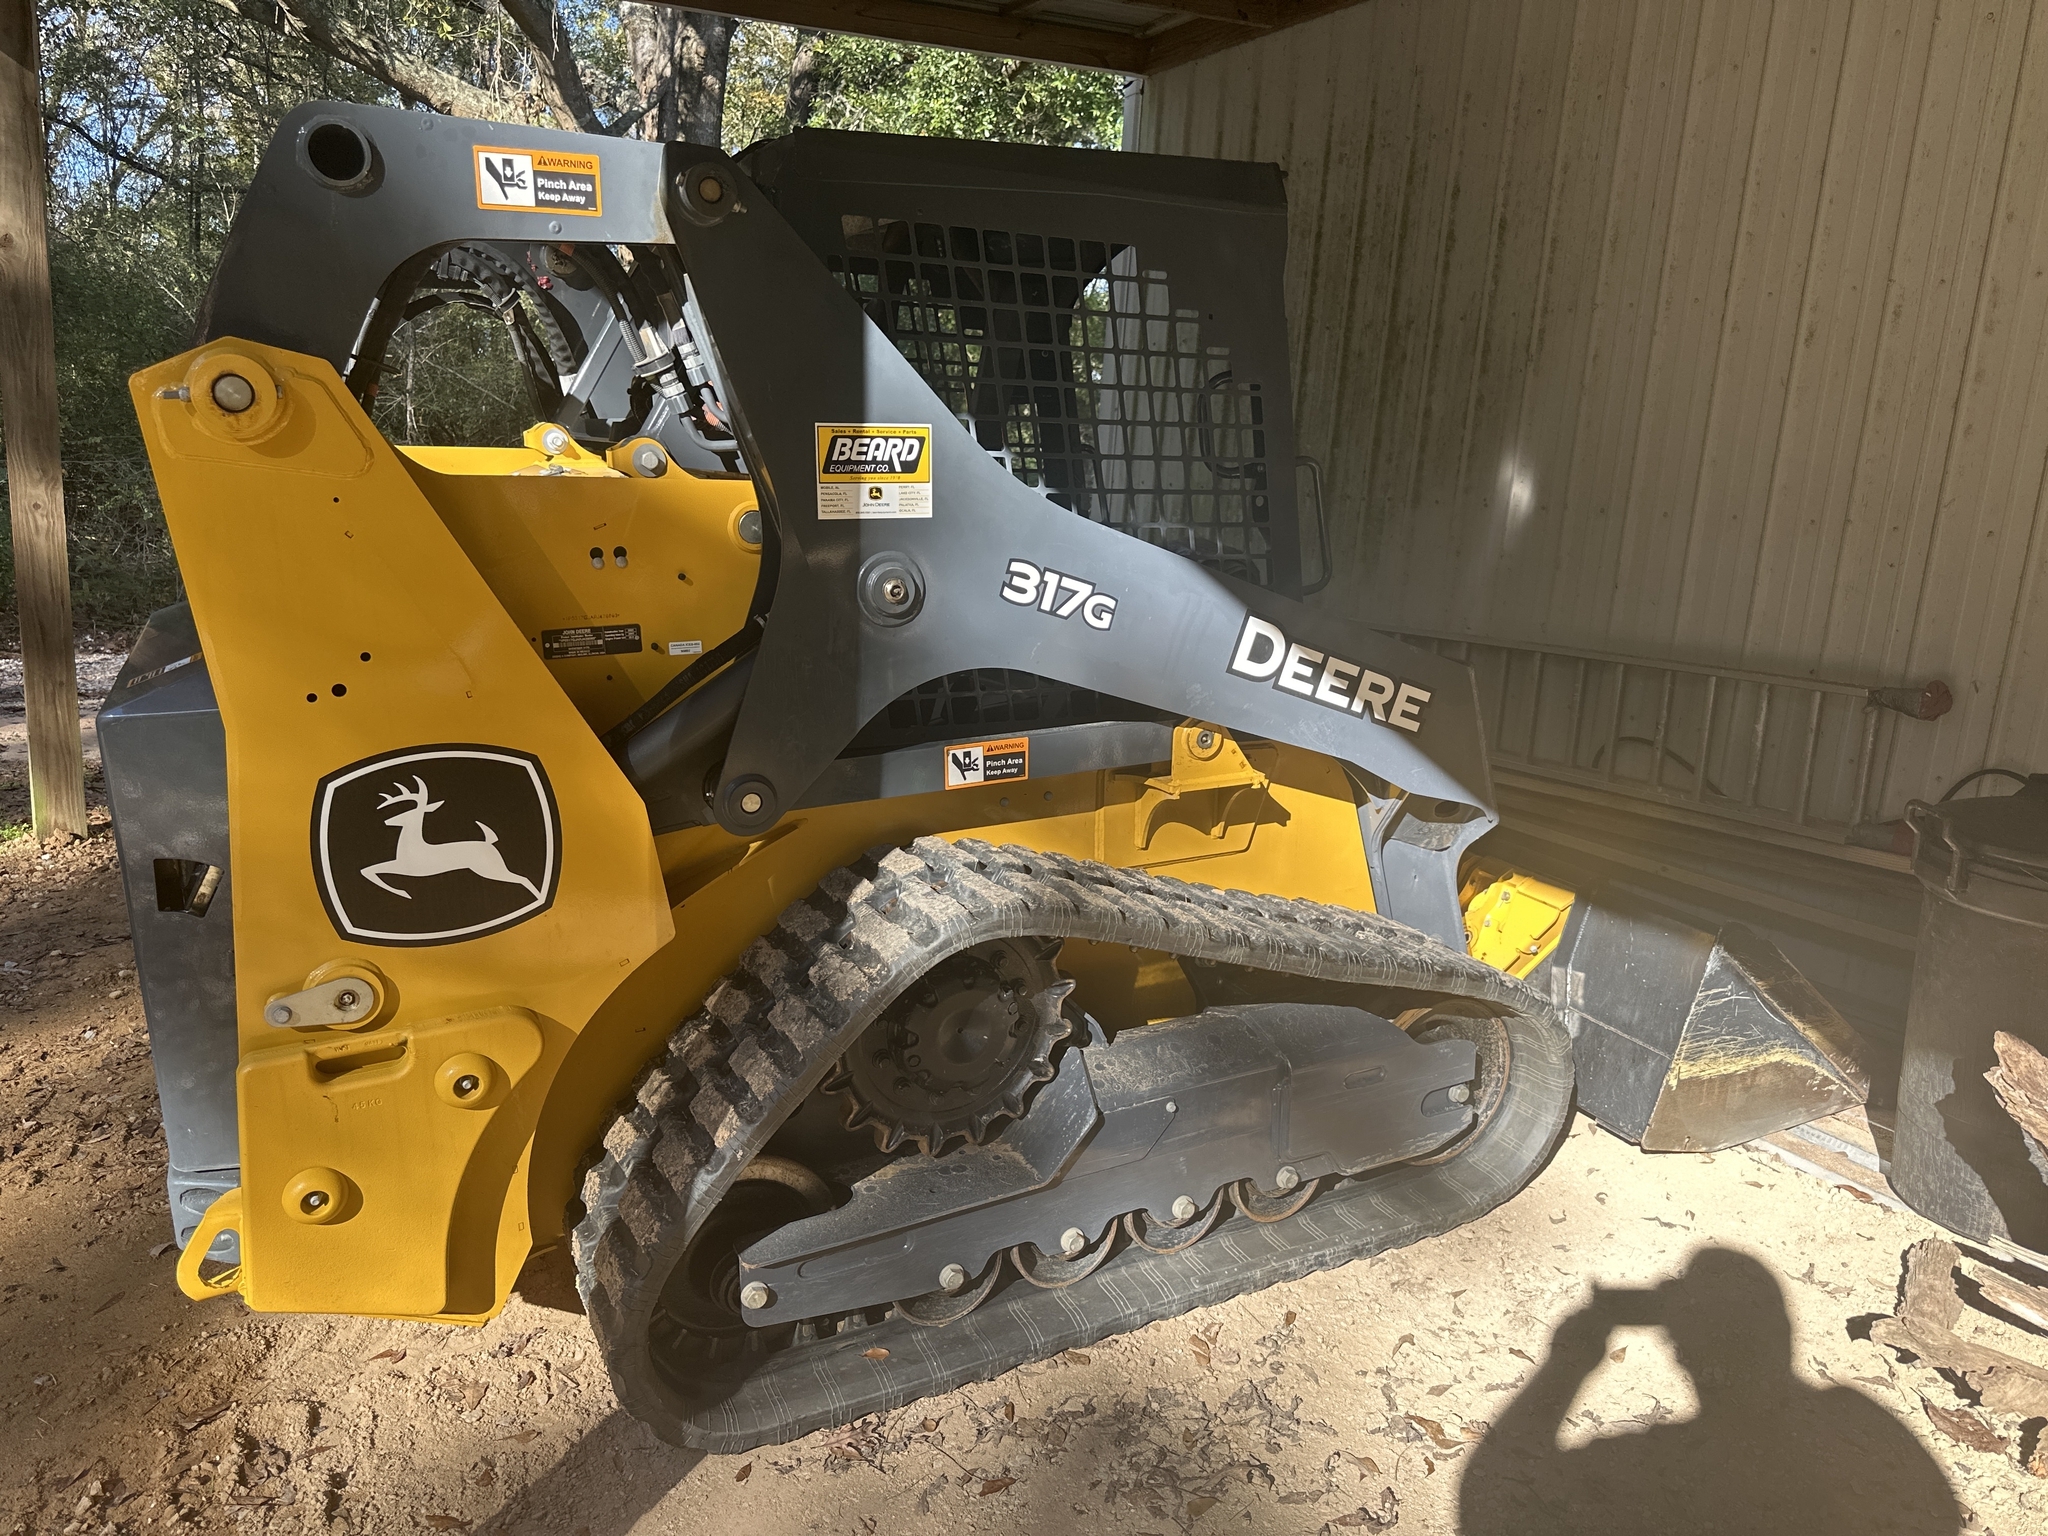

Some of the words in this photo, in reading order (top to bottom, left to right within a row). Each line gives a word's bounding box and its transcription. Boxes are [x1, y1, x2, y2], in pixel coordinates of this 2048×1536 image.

[546, 157, 593, 170] WARNING
[537, 178, 567, 190] Pinch
[568, 180, 592, 192] Area
[538, 192, 561, 202] Keep
[562, 193, 586, 205] Away
[832, 437, 920, 472] BEARD
[830, 464, 876, 472] EQUIPMENT
[876, 464, 890, 472] CO.
[1000, 560, 1117, 630] 317G
[1231, 614, 1432, 733] DEERE
[994, 742, 1024, 751] WARNING
